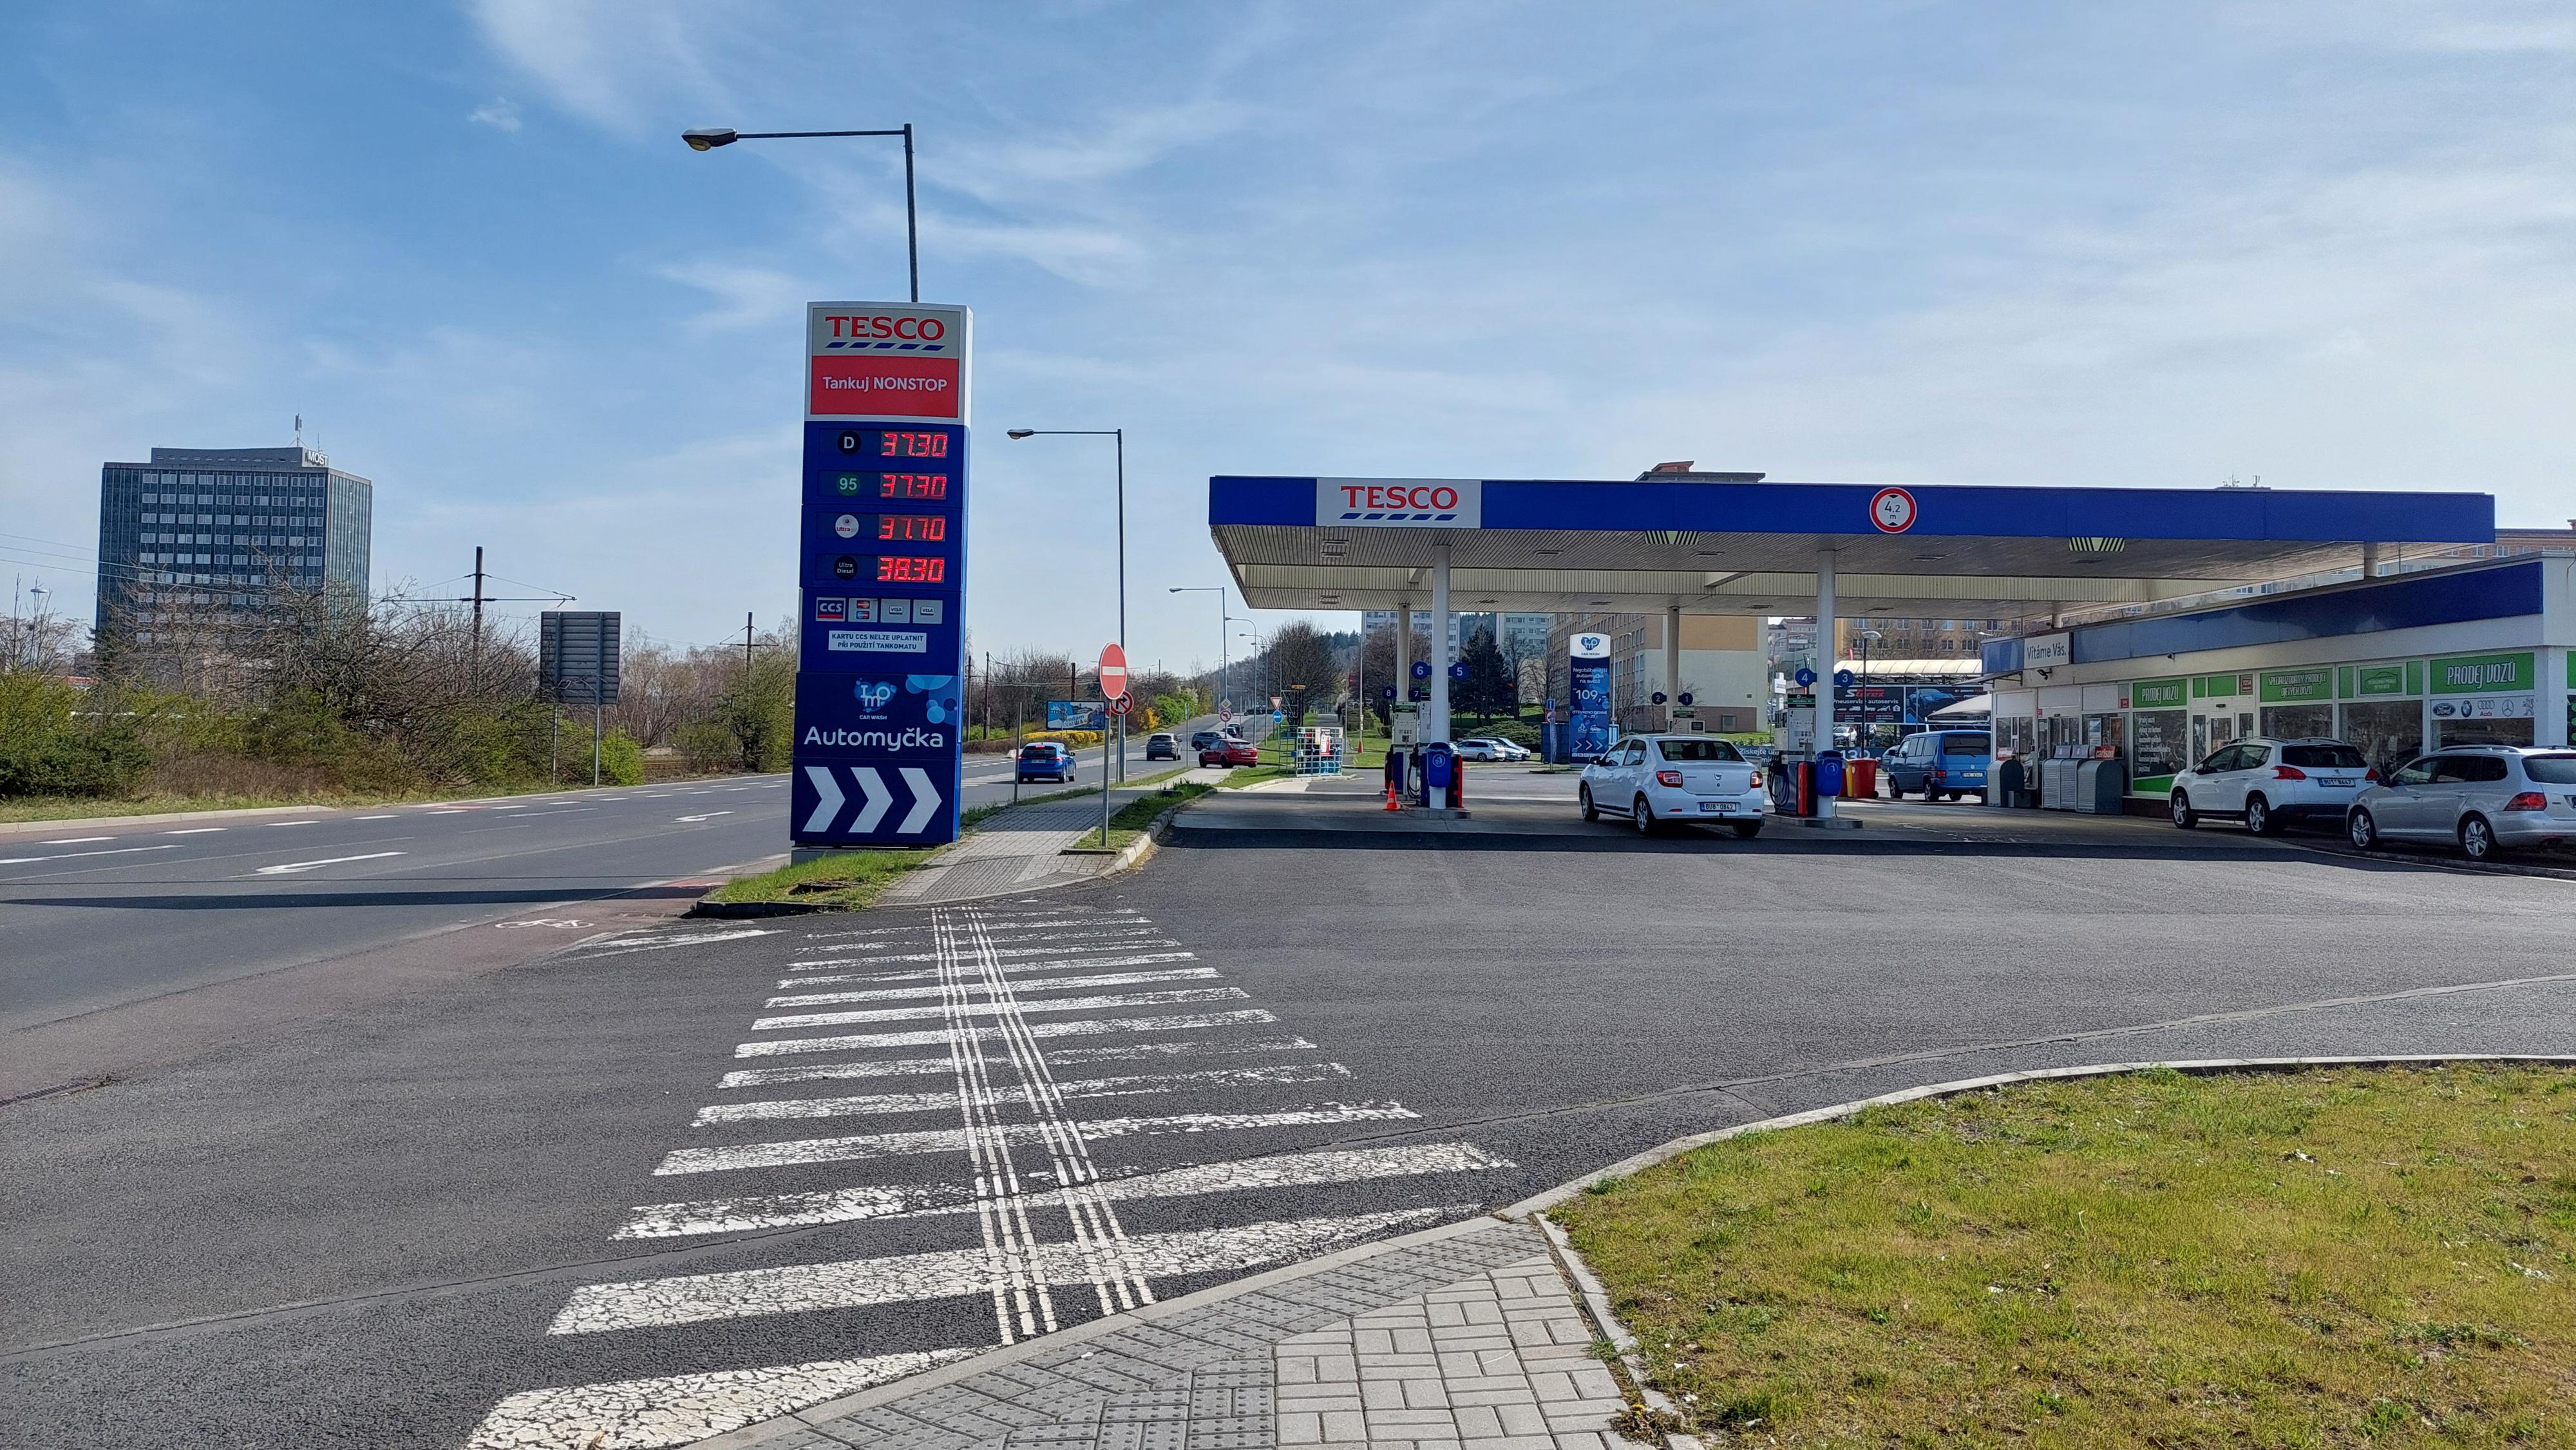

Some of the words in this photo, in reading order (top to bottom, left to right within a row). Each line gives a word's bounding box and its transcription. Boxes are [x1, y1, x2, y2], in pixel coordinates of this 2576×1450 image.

[825, 316, 945, 341] TESCO
[822, 377, 870, 393] Tankuj
[874, 377, 948, 392] NONSTOP
[843, 437, 855, 449] D
[881, 433, 947, 457] 37.30
[308, 450, 328, 467] MOST
[839, 478, 858, 491] 95
[879, 474, 947, 497] 37.30
[1340, 485, 1458, 510] TESCO
[1884, 501, 1900, 513] 4.2
[877, 557, 944, 581] 38.30
[819, 603, 842, 613] CCS
[2027, 645, 2051, 660] Vítáme
[1417, 666, 1423, 675] 6
[1457, 667, 1463, 676] 5
[1801, 673, 1808, 683] 4
[1842, 673, 1848, 683] 3
[2447, 665, 2483, 690] PRODEJ
[2486, 657, 2515, 683] VOZŮ
[2142, 688, 2162, 705] PRODEJ
[2163, 683, 2179, 701] VOZŮ
[804, 726, 943, 752] Automyčka
